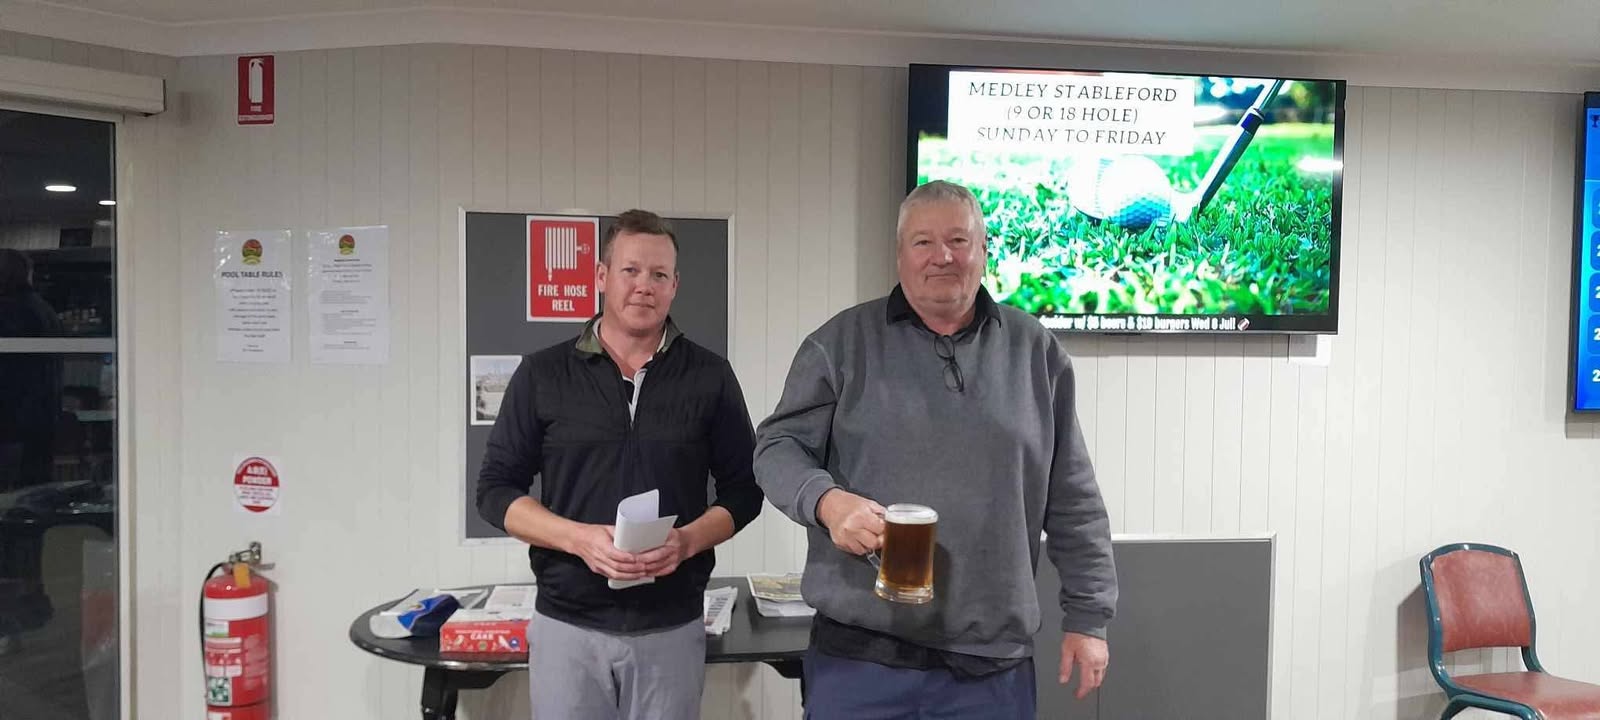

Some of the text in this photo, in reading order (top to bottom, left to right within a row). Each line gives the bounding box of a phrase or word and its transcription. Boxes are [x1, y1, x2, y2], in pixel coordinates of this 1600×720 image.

[968, 81, 1177, 102] MEDLEY STABLEFORD
[1007, 105, 1139, 124] (9 OR 18 HOLE)
[977, 127, 1166, 145] SUNDAY TO FRIDAY
[537, 284, 588, 297] FIRE HOSE
[552, 299, 575, 312] REEL
[1100, 315, 1126, 330] beers
[1154, 316, 1190, 331] burgers
[1191, 316, 1210, 330] Wed
